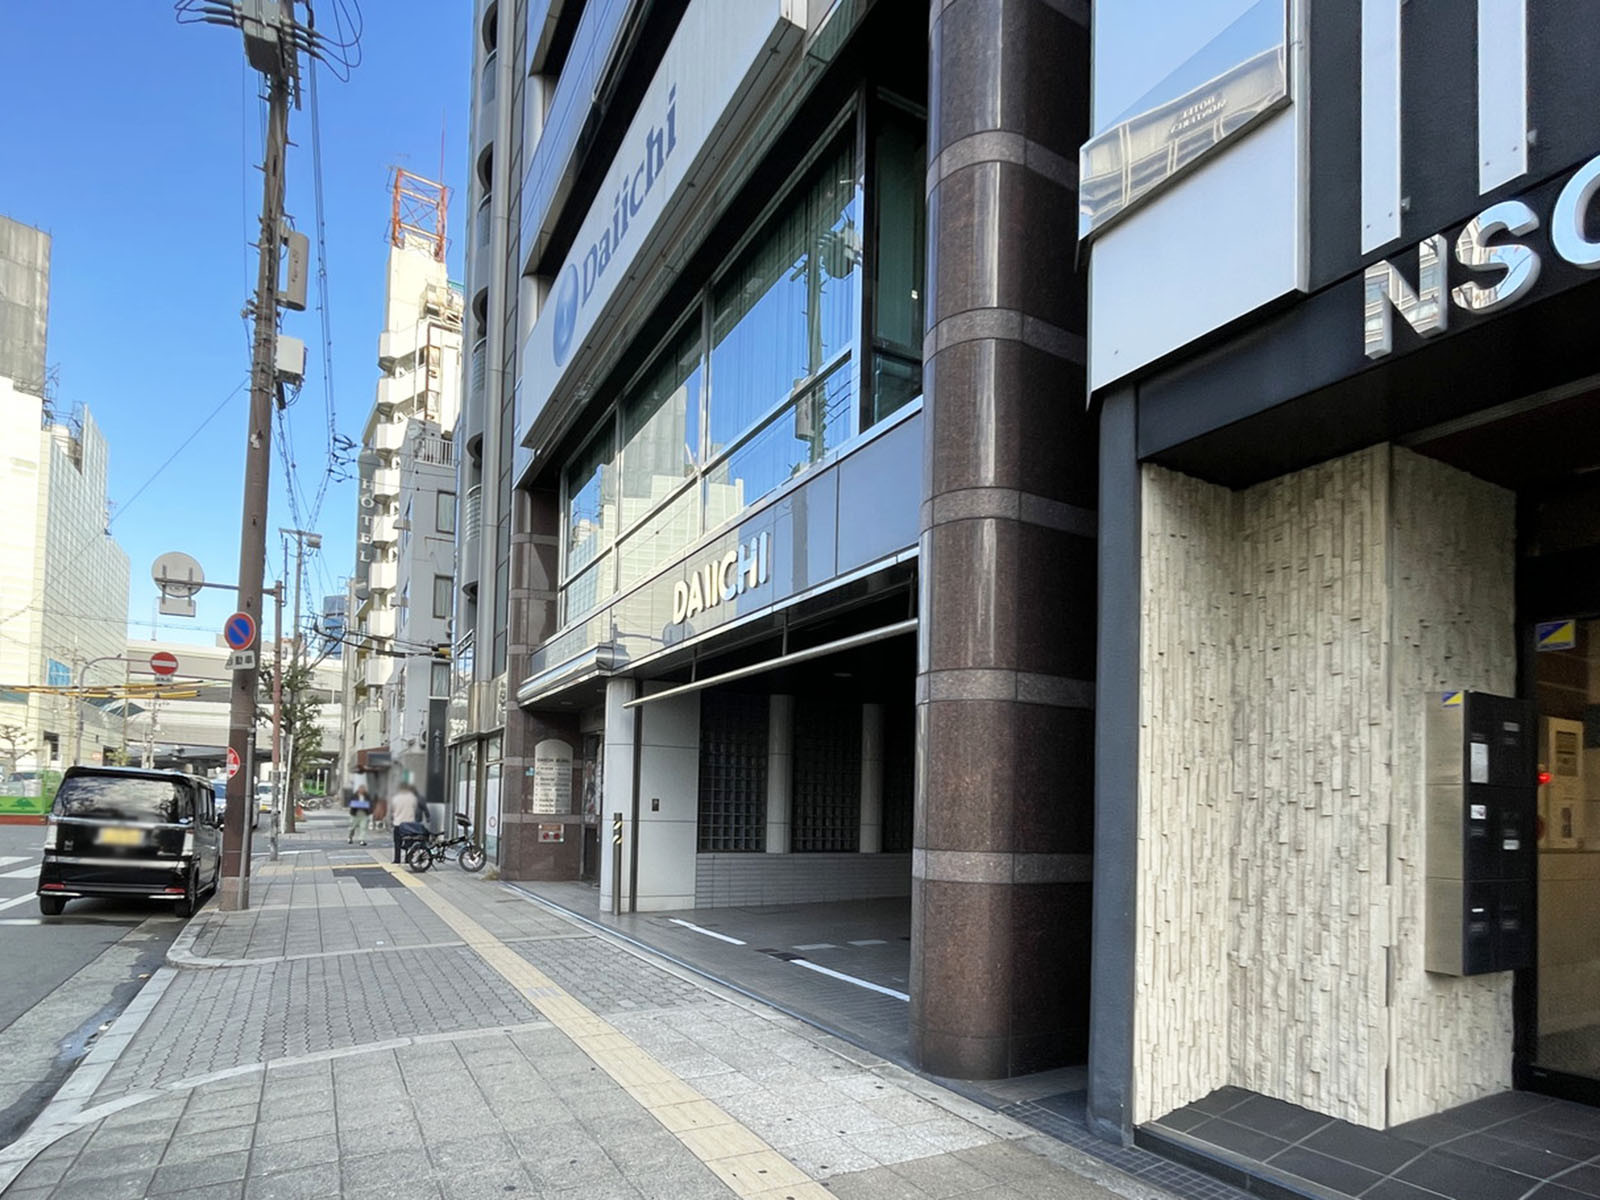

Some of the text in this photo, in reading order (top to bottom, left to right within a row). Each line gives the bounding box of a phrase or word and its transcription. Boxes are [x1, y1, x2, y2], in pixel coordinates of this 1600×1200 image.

[581, 82, 677, 308] Daiichi
[359, 478, 374, 563] HOTEL
[672, 531, 769, 625] DAIICHI
